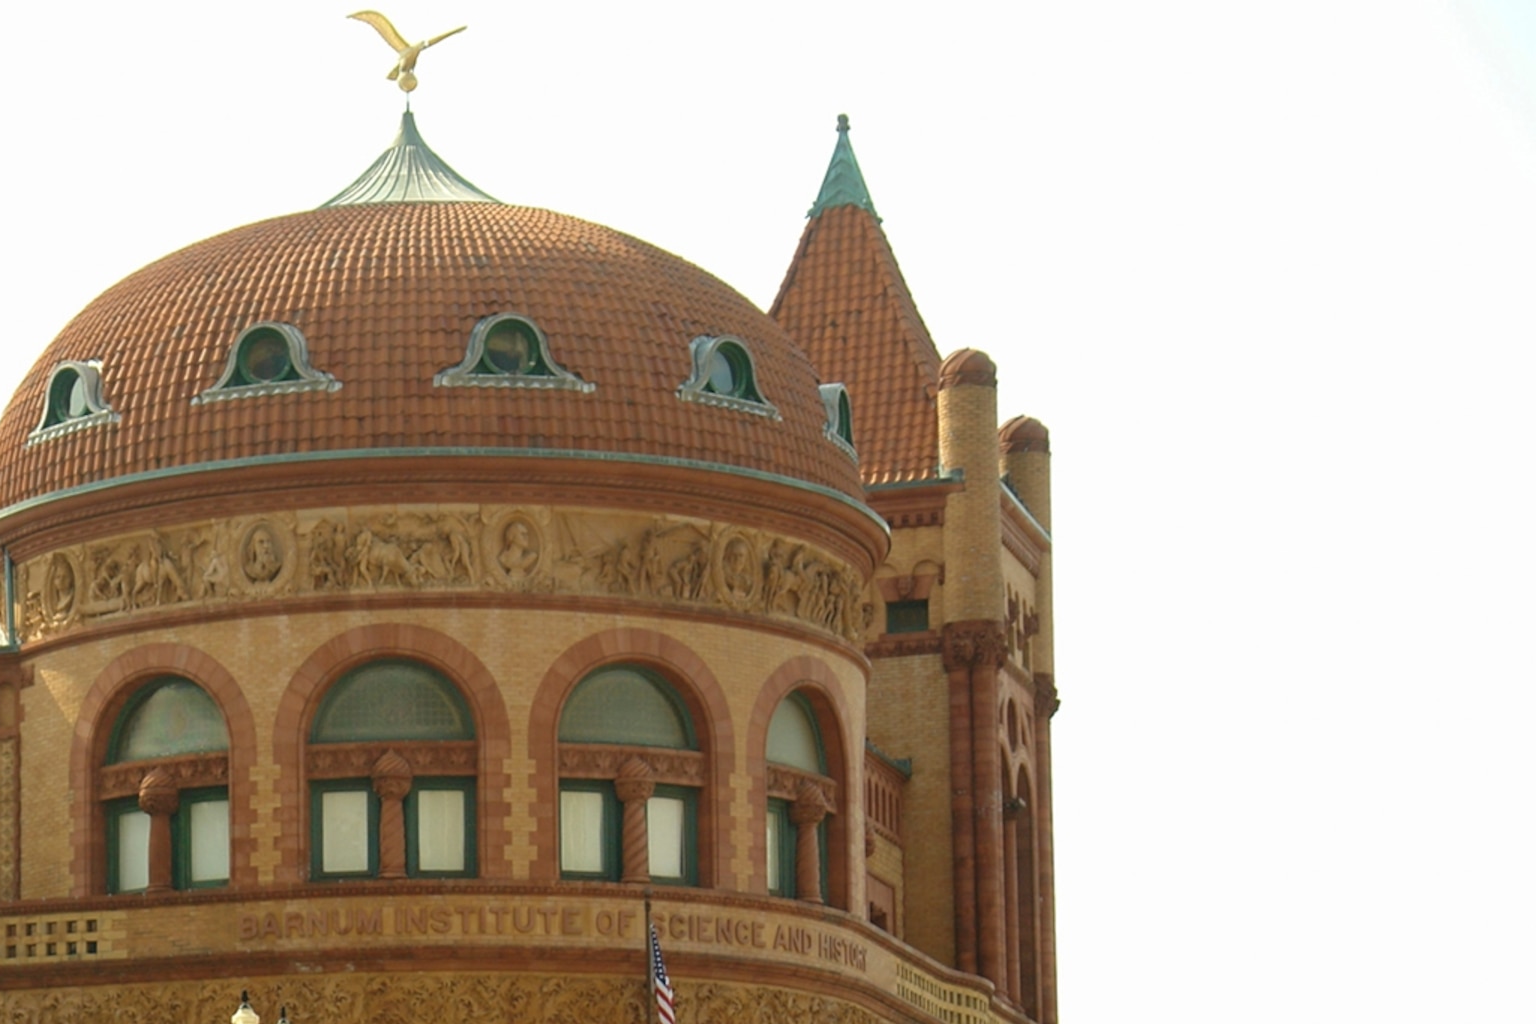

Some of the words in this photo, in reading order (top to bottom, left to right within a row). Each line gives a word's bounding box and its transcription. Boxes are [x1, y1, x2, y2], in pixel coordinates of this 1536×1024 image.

[239, 907, 383, 941] BARNUM
[394, 904, 584, 936] INSTITUTE
[595, 908, 637, 938] OF
[648, 911, 767, 949] SCIENCE
[772, 922, 813, 955] AND
